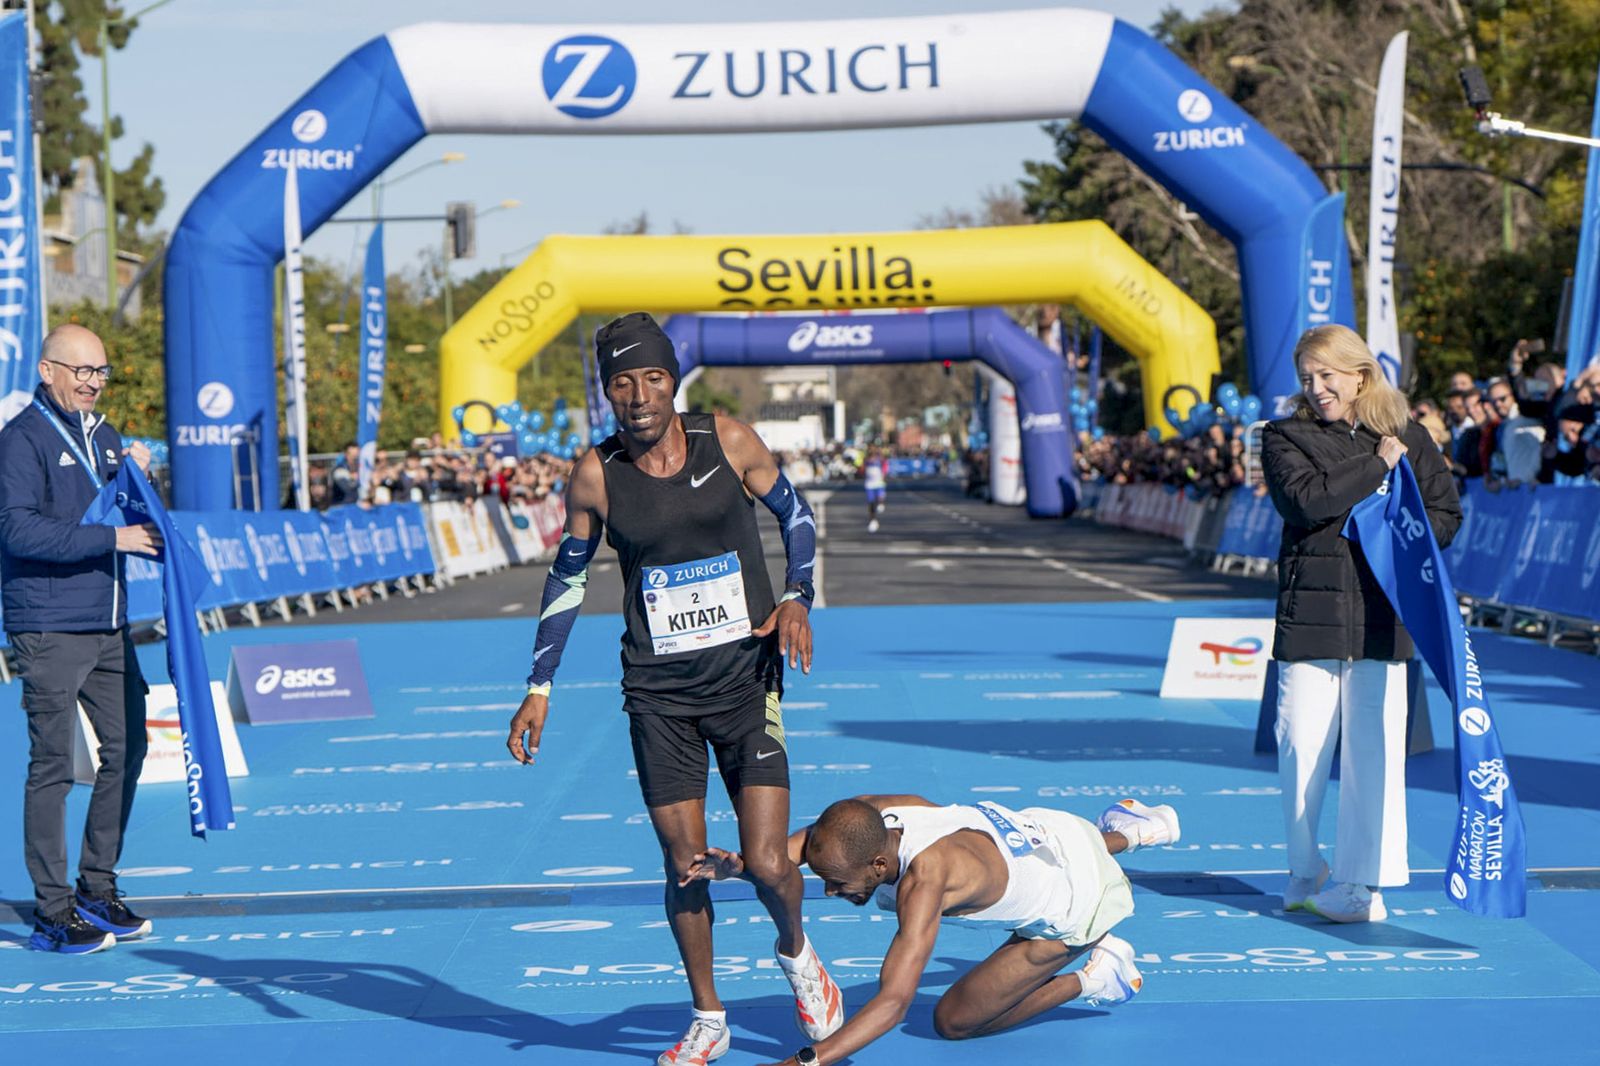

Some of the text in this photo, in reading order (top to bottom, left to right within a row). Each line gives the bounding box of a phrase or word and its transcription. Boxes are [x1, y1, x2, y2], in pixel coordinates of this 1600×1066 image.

[672, 42, 940, 99] ZURICH
[1154, 127, 1245, 152] ZURICH
[261, 148, 354, 170] ZURICH
[717, 246, 933, 293] Sevilla.
[815, 325, 873, 347] asics
[366, 286, 384, 424] ZURICH
[675, 560, 729, 582] ZURICH
[691, 592, 700, 604] 2
[668, 605, 729, 632] KITATA
[281, 667, 336, 688] asics
[1468, 810, 1486, 881] MARATÓN
[1485, 814, 1503, 881] SEVILLA
[212, 859, 452, 874] ZURICH
